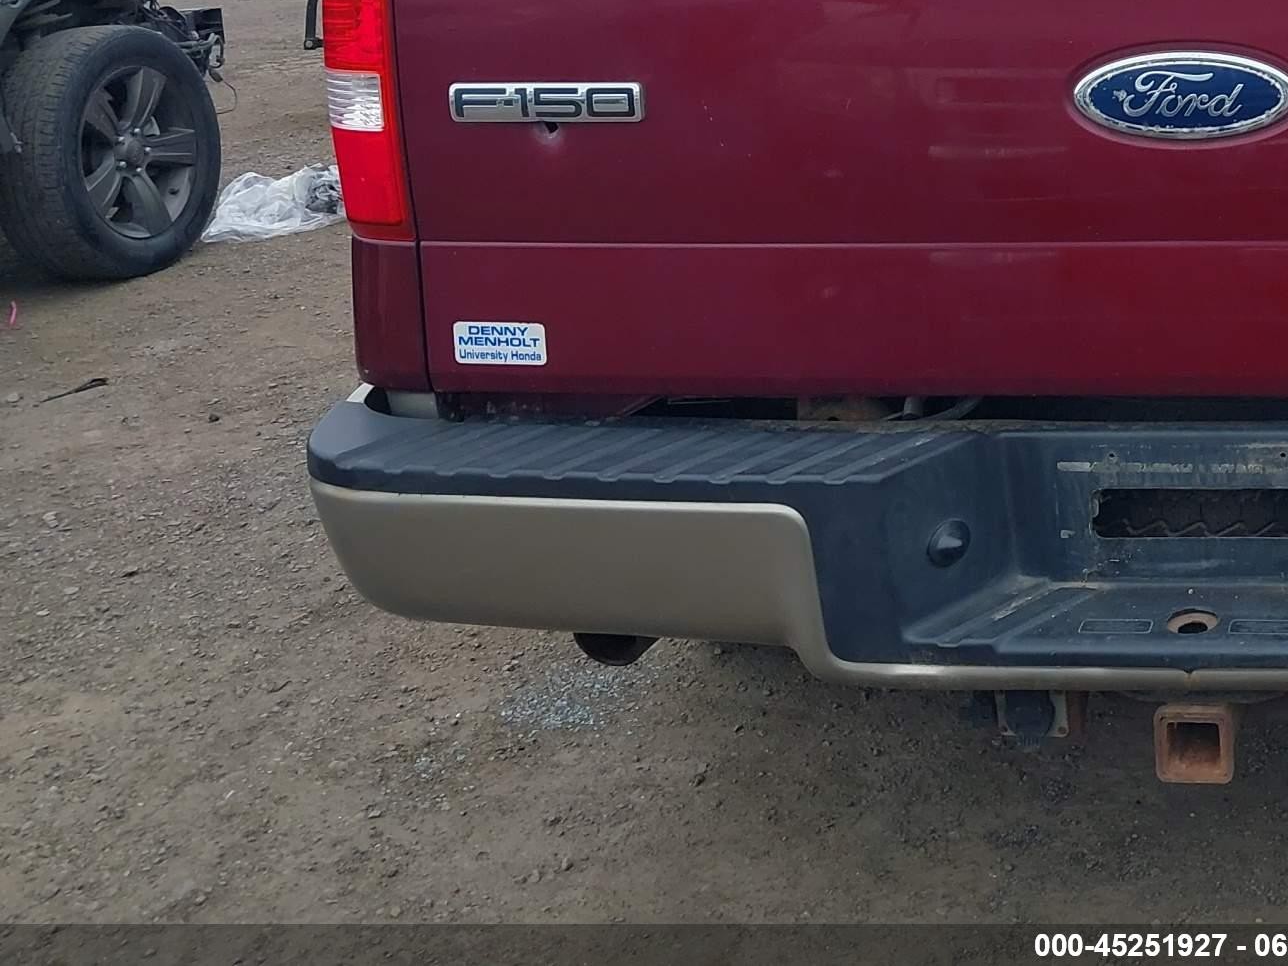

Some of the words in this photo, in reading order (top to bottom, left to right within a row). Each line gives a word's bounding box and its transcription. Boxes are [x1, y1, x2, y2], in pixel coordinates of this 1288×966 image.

[1122, 70, 1244, 117] Ford
[453, 87, 636, 118] F-150
[468, 325, 529, 337] DENNY
[458, 336, 541, 348] MENHOLT
[459, 349, 509, 363] University
[511, 350, 542, 362] Honda
